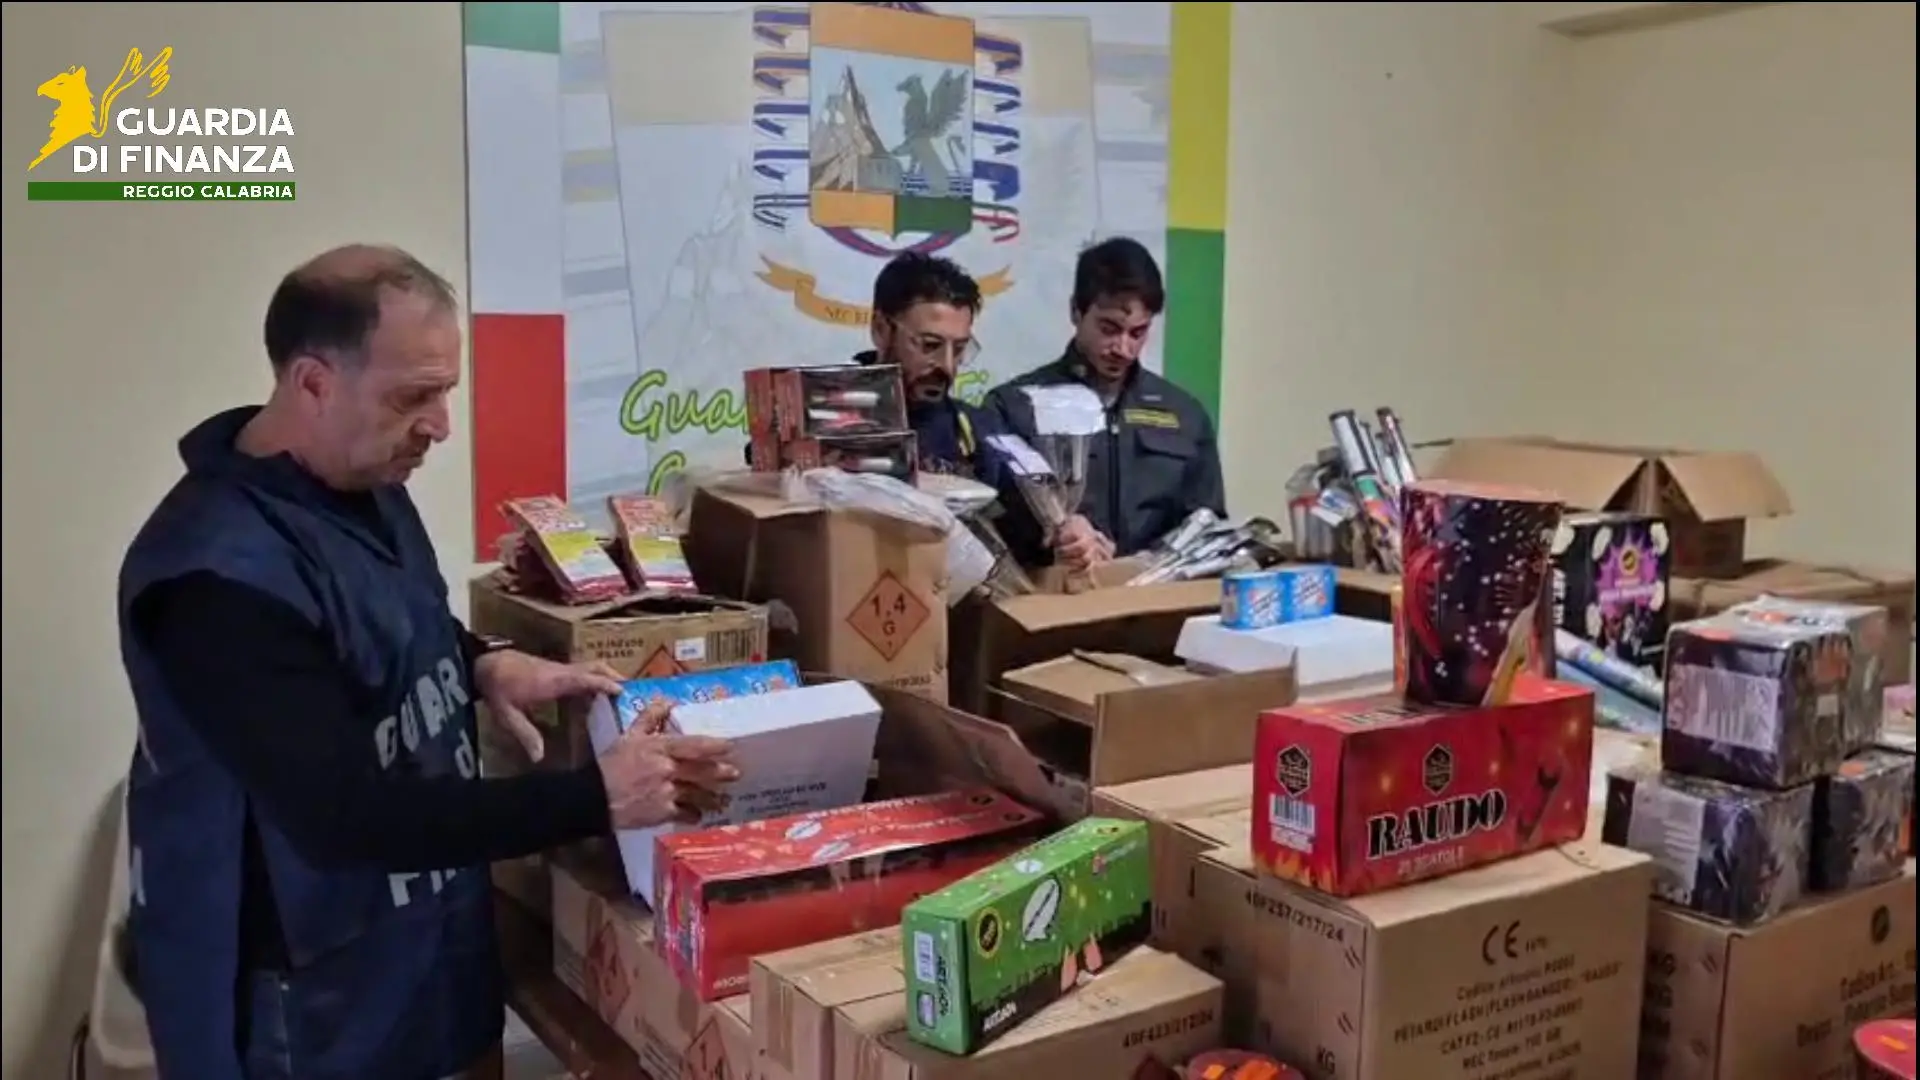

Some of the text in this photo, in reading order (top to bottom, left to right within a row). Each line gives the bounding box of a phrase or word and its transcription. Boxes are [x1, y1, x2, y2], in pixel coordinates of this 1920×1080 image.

[619, 369, 749, 442] Gua
[882, 620, 897, 636] G
[375, 654, 470, 770] GUAR
[454, 728, 476, 780] d
[1366, 788, 1508, 861] RAUDO
[1482, 919, 1521, 966] CE
